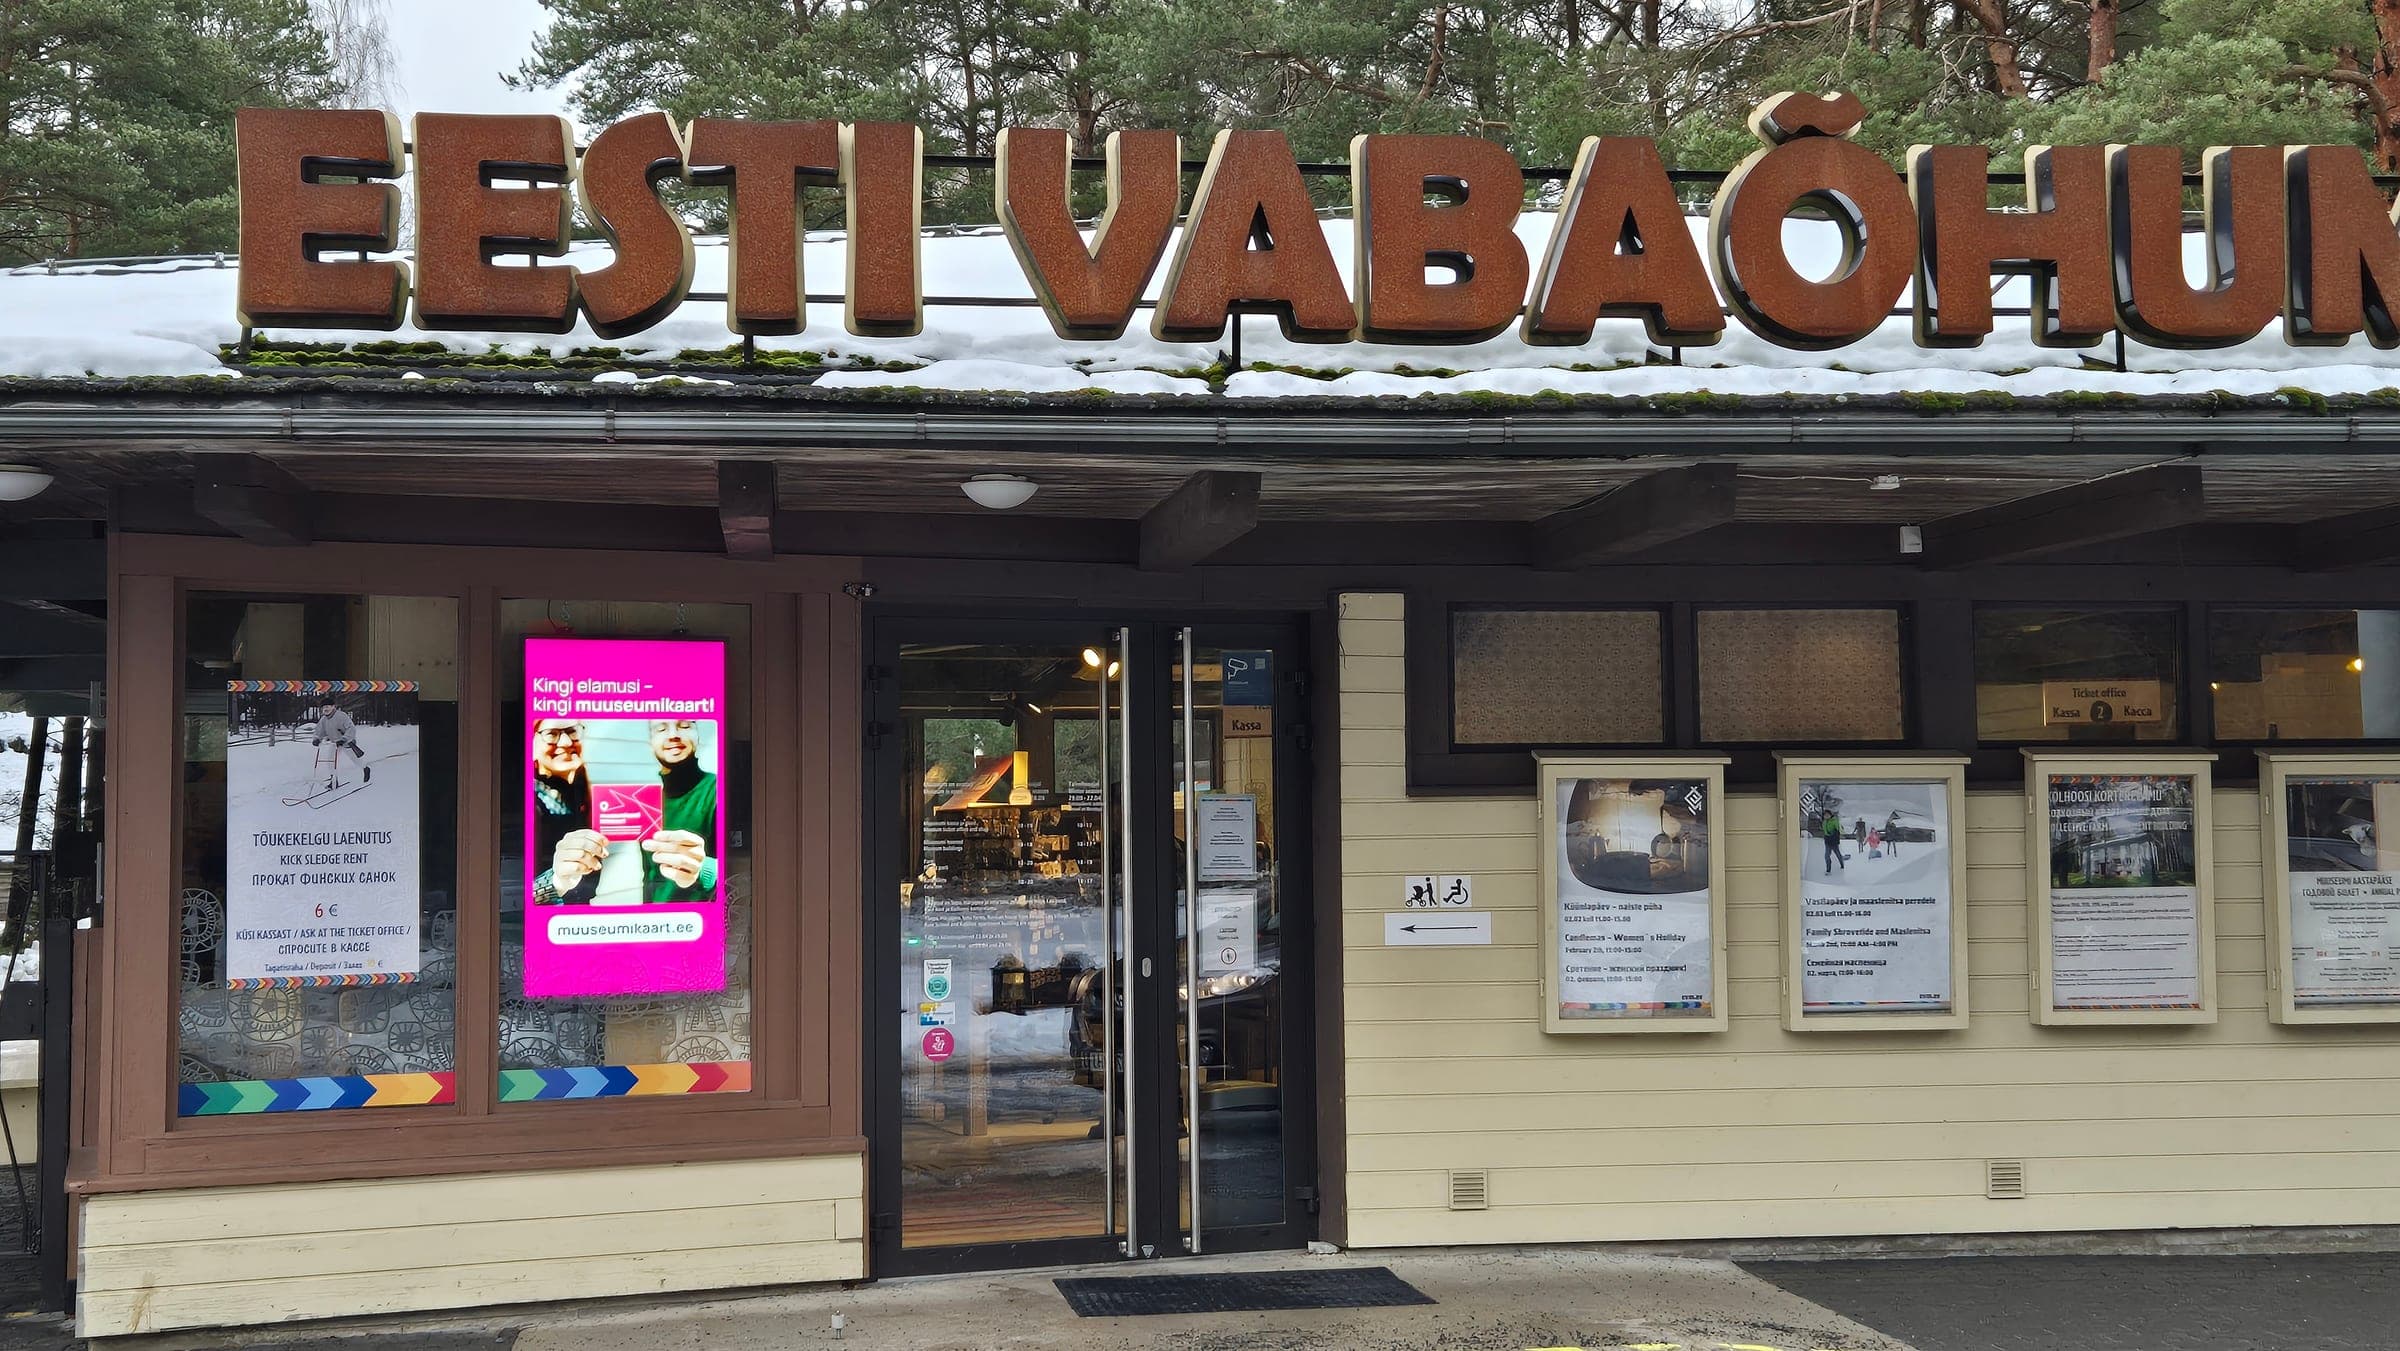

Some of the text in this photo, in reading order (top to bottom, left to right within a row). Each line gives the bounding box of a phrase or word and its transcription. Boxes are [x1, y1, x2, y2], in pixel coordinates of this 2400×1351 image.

[236, 107, 923, 340] EESTI
[533, 677, 574, 697] Kingi
[576, 678, 641, 694] elamusi
[2072, 687, 2127, 699] Ticket office
[533, 697, 715, 716] kingi muuseumikaart!
[2052, 706, 2104, 719] Kassa 2
[1231, 719, 1262, 731] Kassa
[253, 831, 392, 847] TÕUKEKELGU LAENUTUS
[280, 853, 368, 865] KICK SLEDGE RENT
[252, 873, 296, 886] ПРОКАТ
[359, 871, 396, 883] САНОК
[1850, 897, 1858, 906] ja
[315, 903, 338, 918] 6 €
[236, 928, 255, 940] KÜSI
[257, 928, 291, 940] KASSAST
[300, 927, 315, 938] ASK
[317, 927, 328, 938] AT
[330, 927, 345, 937] THE
[348, 926, 376, 937] TICKET
[377, 925, 404, 936] OFFICE
[557, 922, 694, 937] muuseumikaart.ee
[1806, 928, 1832, 937] Family
[1656, 933, 1686, 943] Holiday
[340, 941, 370, 952] КАССЕ
